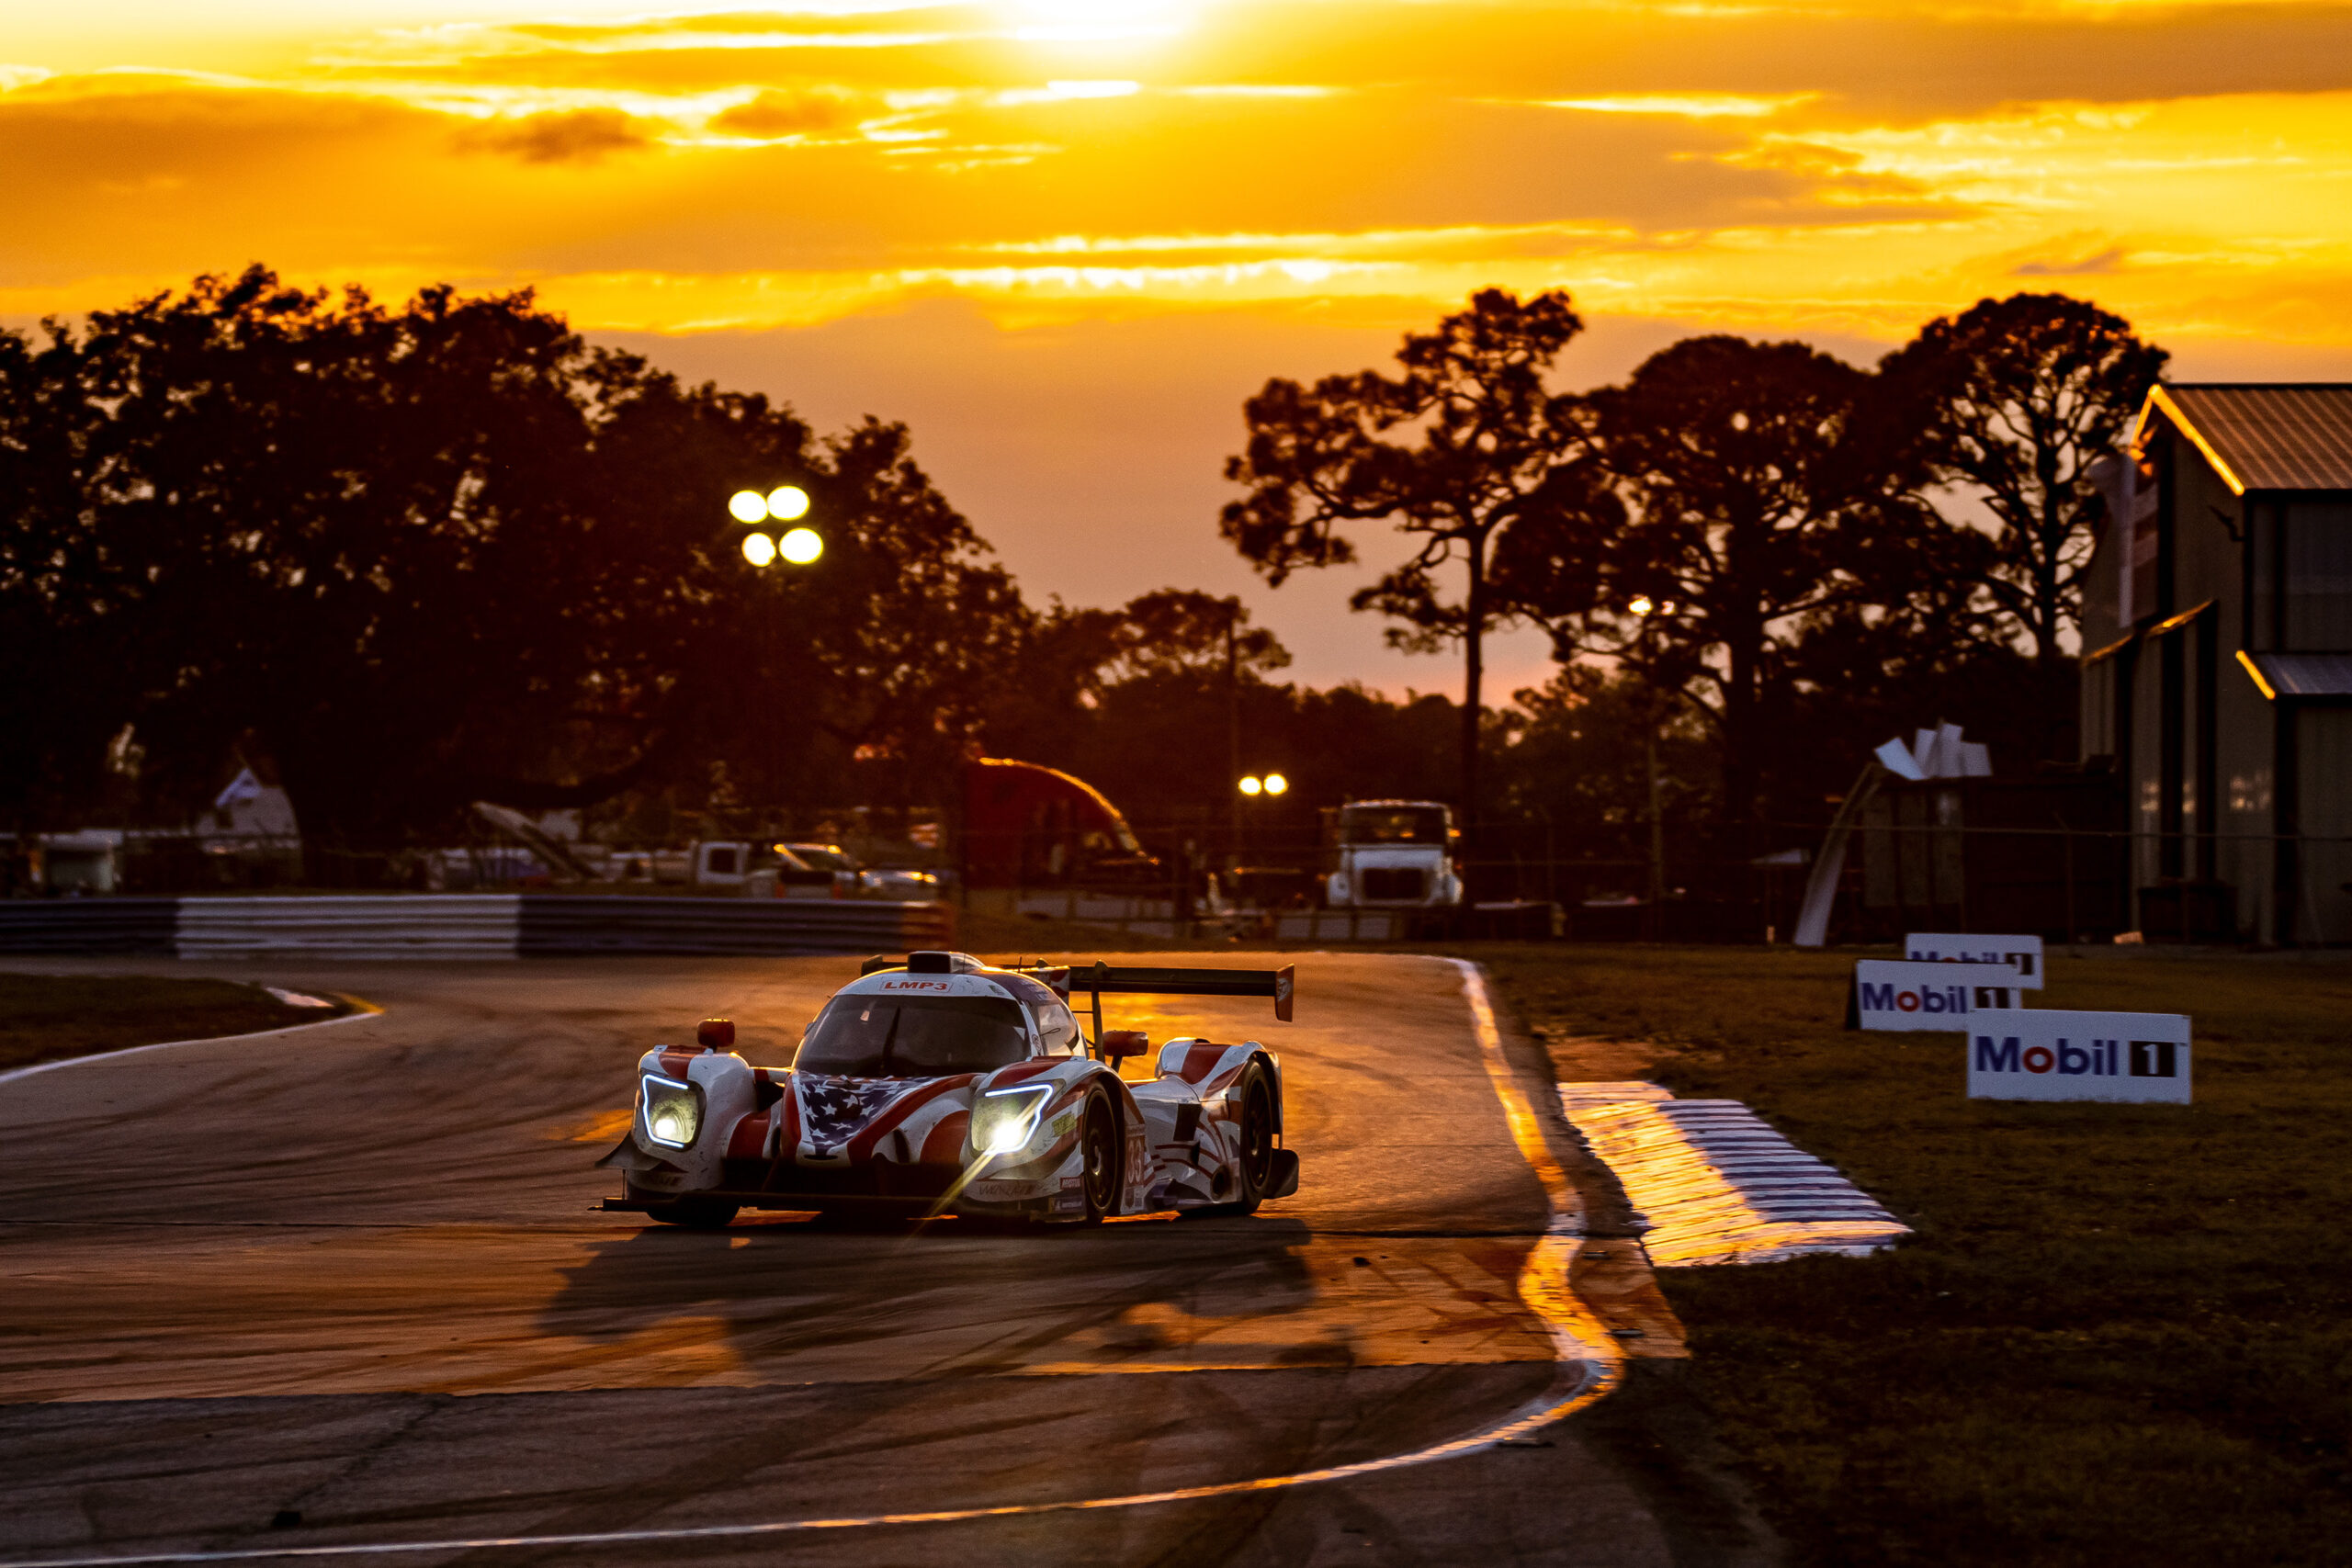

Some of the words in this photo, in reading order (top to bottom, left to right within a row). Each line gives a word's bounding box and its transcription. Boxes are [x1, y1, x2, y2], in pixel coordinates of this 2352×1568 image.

[884, 981, 948, 991] LMP3
[1861, 982, 1967, 1014] Mobil
[1975, 1036, 2119, 1075] Mobil
